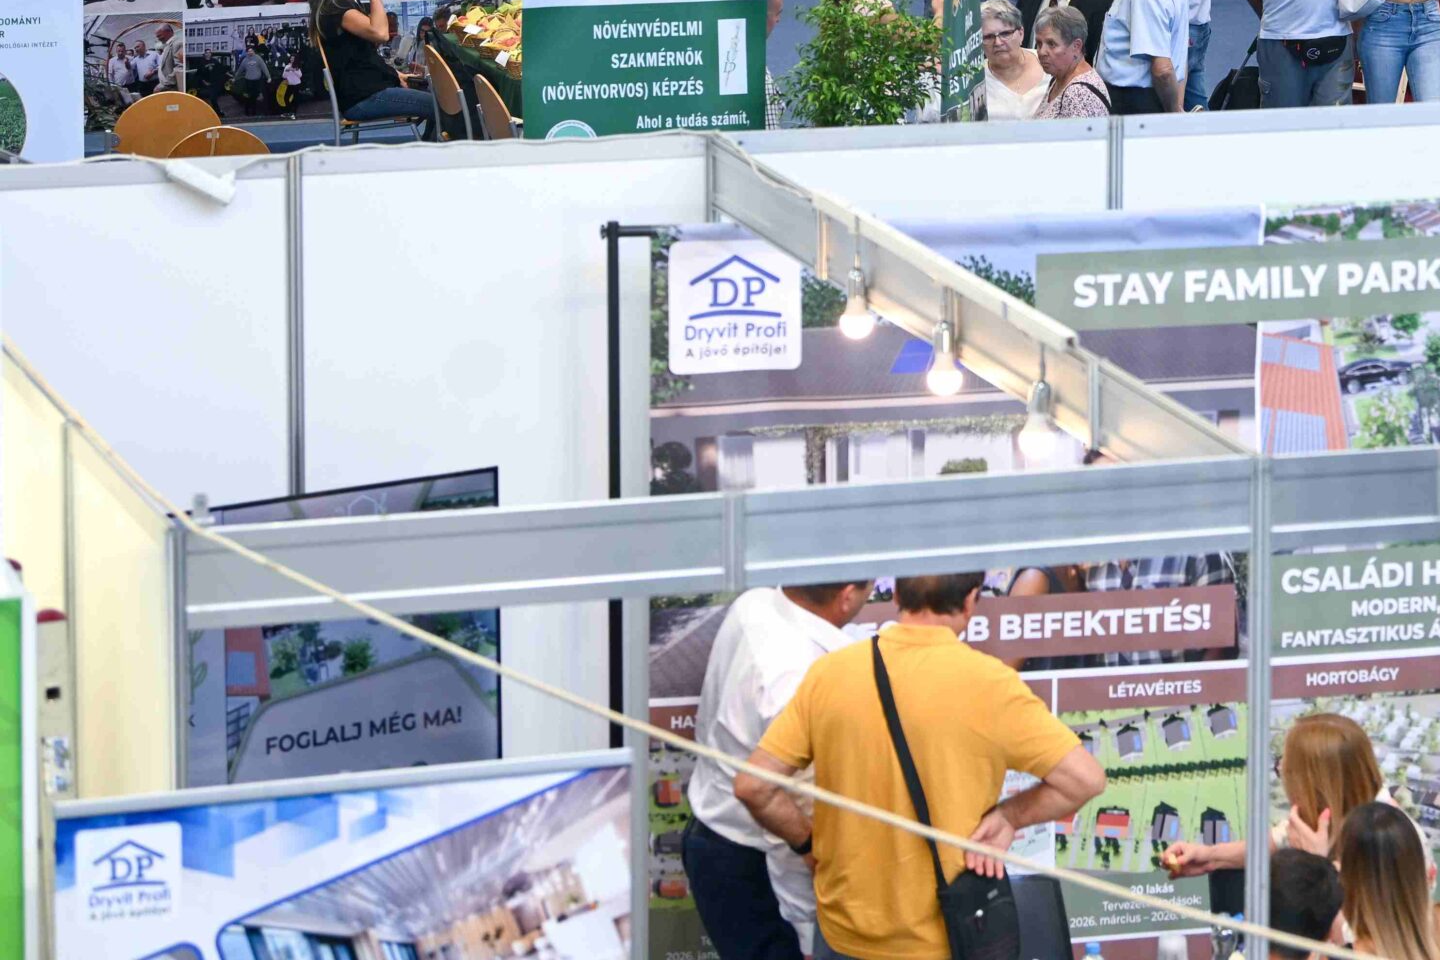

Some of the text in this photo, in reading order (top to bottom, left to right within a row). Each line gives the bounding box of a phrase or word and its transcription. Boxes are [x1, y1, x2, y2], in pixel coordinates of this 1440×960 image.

[593, 18, 702, 40] NÖVÉNYVÉDELMI
[610, 47, 703, 69] SZAKMÉRNÖK
[542, 77, 704, 104] (NÖVÉNYORVOS) KÉPZÉS
[636, 110, 750, 129] Ahol a tudás számít,
[708, 277, 766, 307] DP
[1073, 271, 1173, 308] STAY
[1184, 264, 1327, 303] FAMILY
[684, 321, 787, 343] Dryvit Profi
[685, 344, 787, 360] A jövő építője!
[1281, 556, 1414, 594] CSALÁDI
[999, 601, 1211, 641] BEFEKTETÉS!
[1281, 622, 1424, 648] FANTASZTIKUS
[1305, 665, 1400, 686] HORTOBÁGY
[1108, 678, 1202, 699] LÉTAVÉRTES
[266, 706, 462, 755] FOGLALJ MÉG MA!
[110, 855, 153, 881] DP
[1130, 882, 1174, 895] 20 lakás
[1070, 917, 1098, 928] 2026.
[1100, 912, 1141, 926] március
